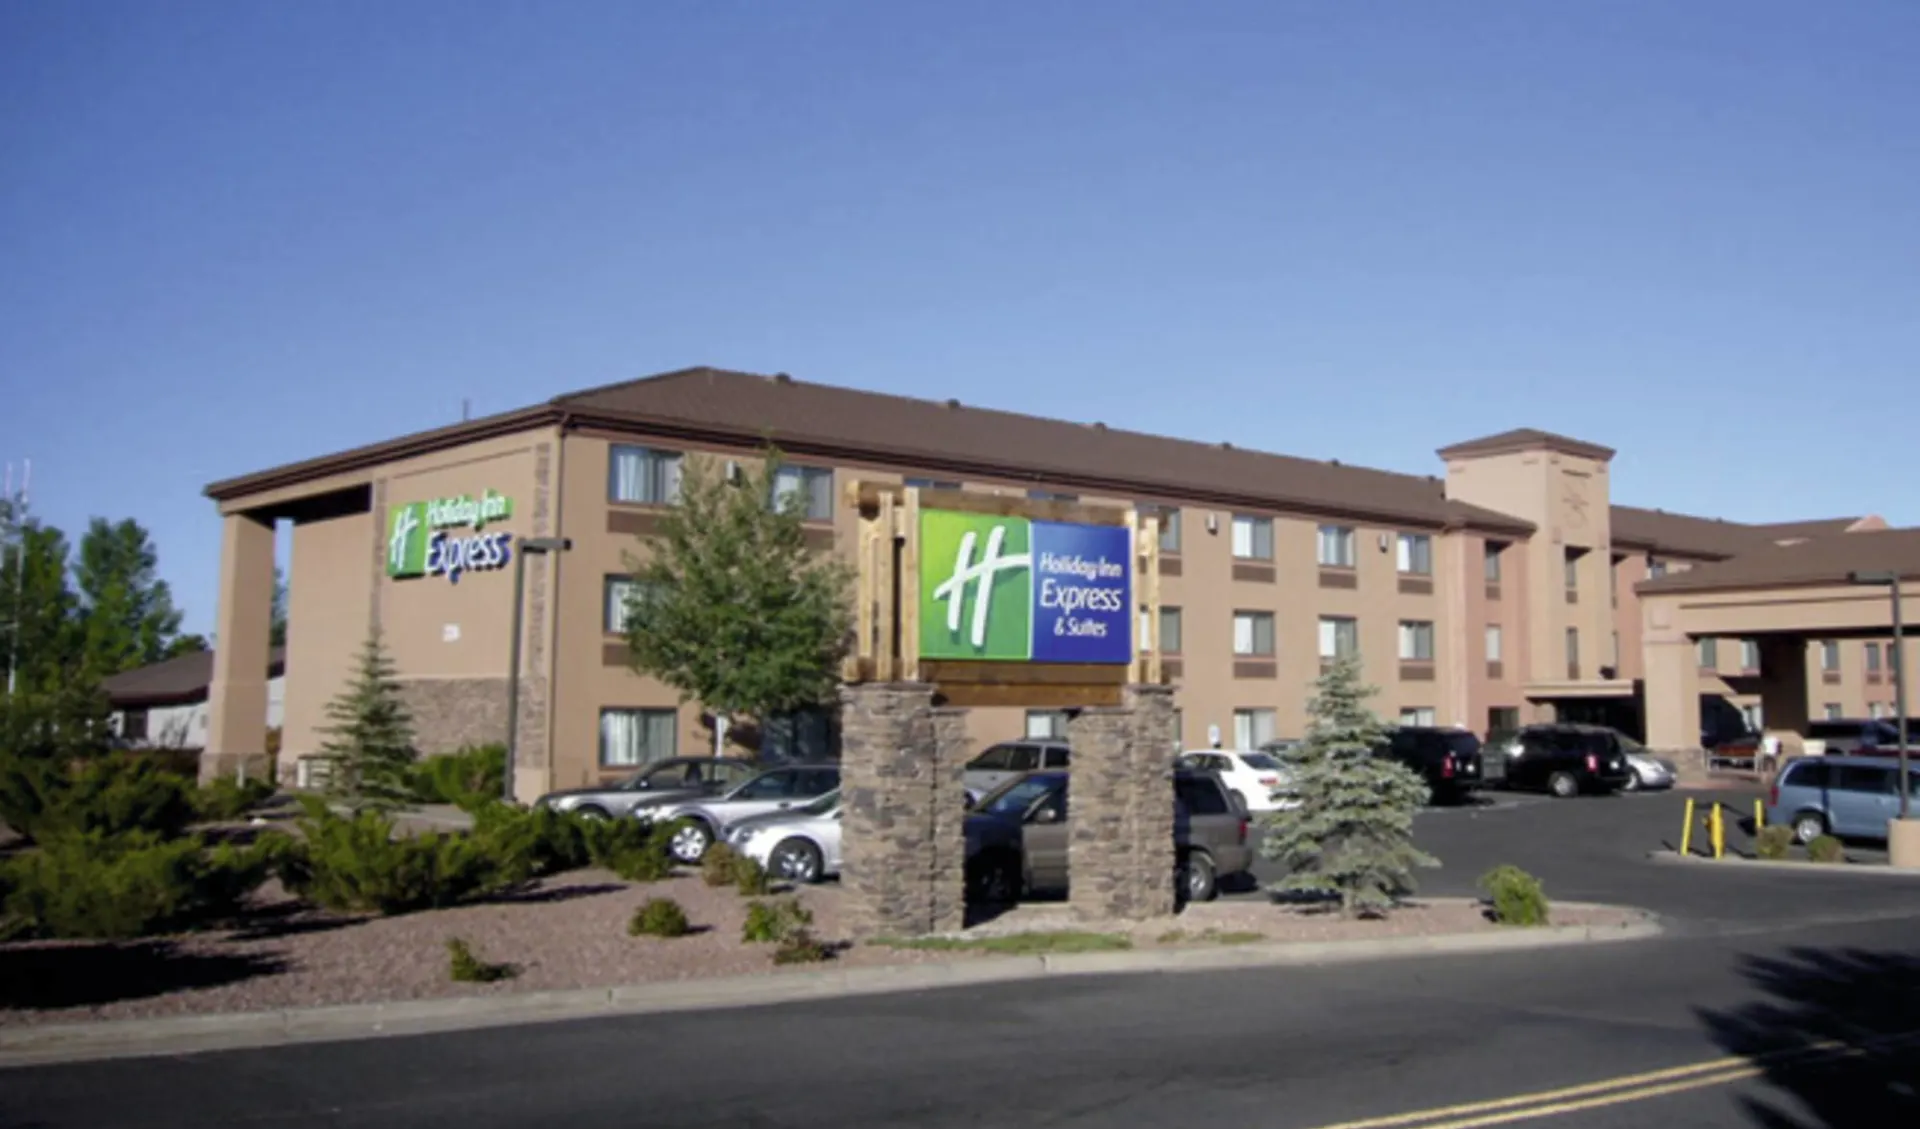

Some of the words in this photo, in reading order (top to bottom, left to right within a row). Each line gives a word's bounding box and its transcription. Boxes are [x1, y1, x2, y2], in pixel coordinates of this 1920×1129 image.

[426, 494, 479, 528] Holiday
[482, 487, 506, 518] Inn
[424, 532, 507, 581] Express
[1040, 552, 1096, 580] Holiday
[1098, 555, 1123, 577] Inn
[1040, 578, 1123, 616] Express
[1053, 616, 1065, 637] &
[1066, 617, 1108, 638] Suites
